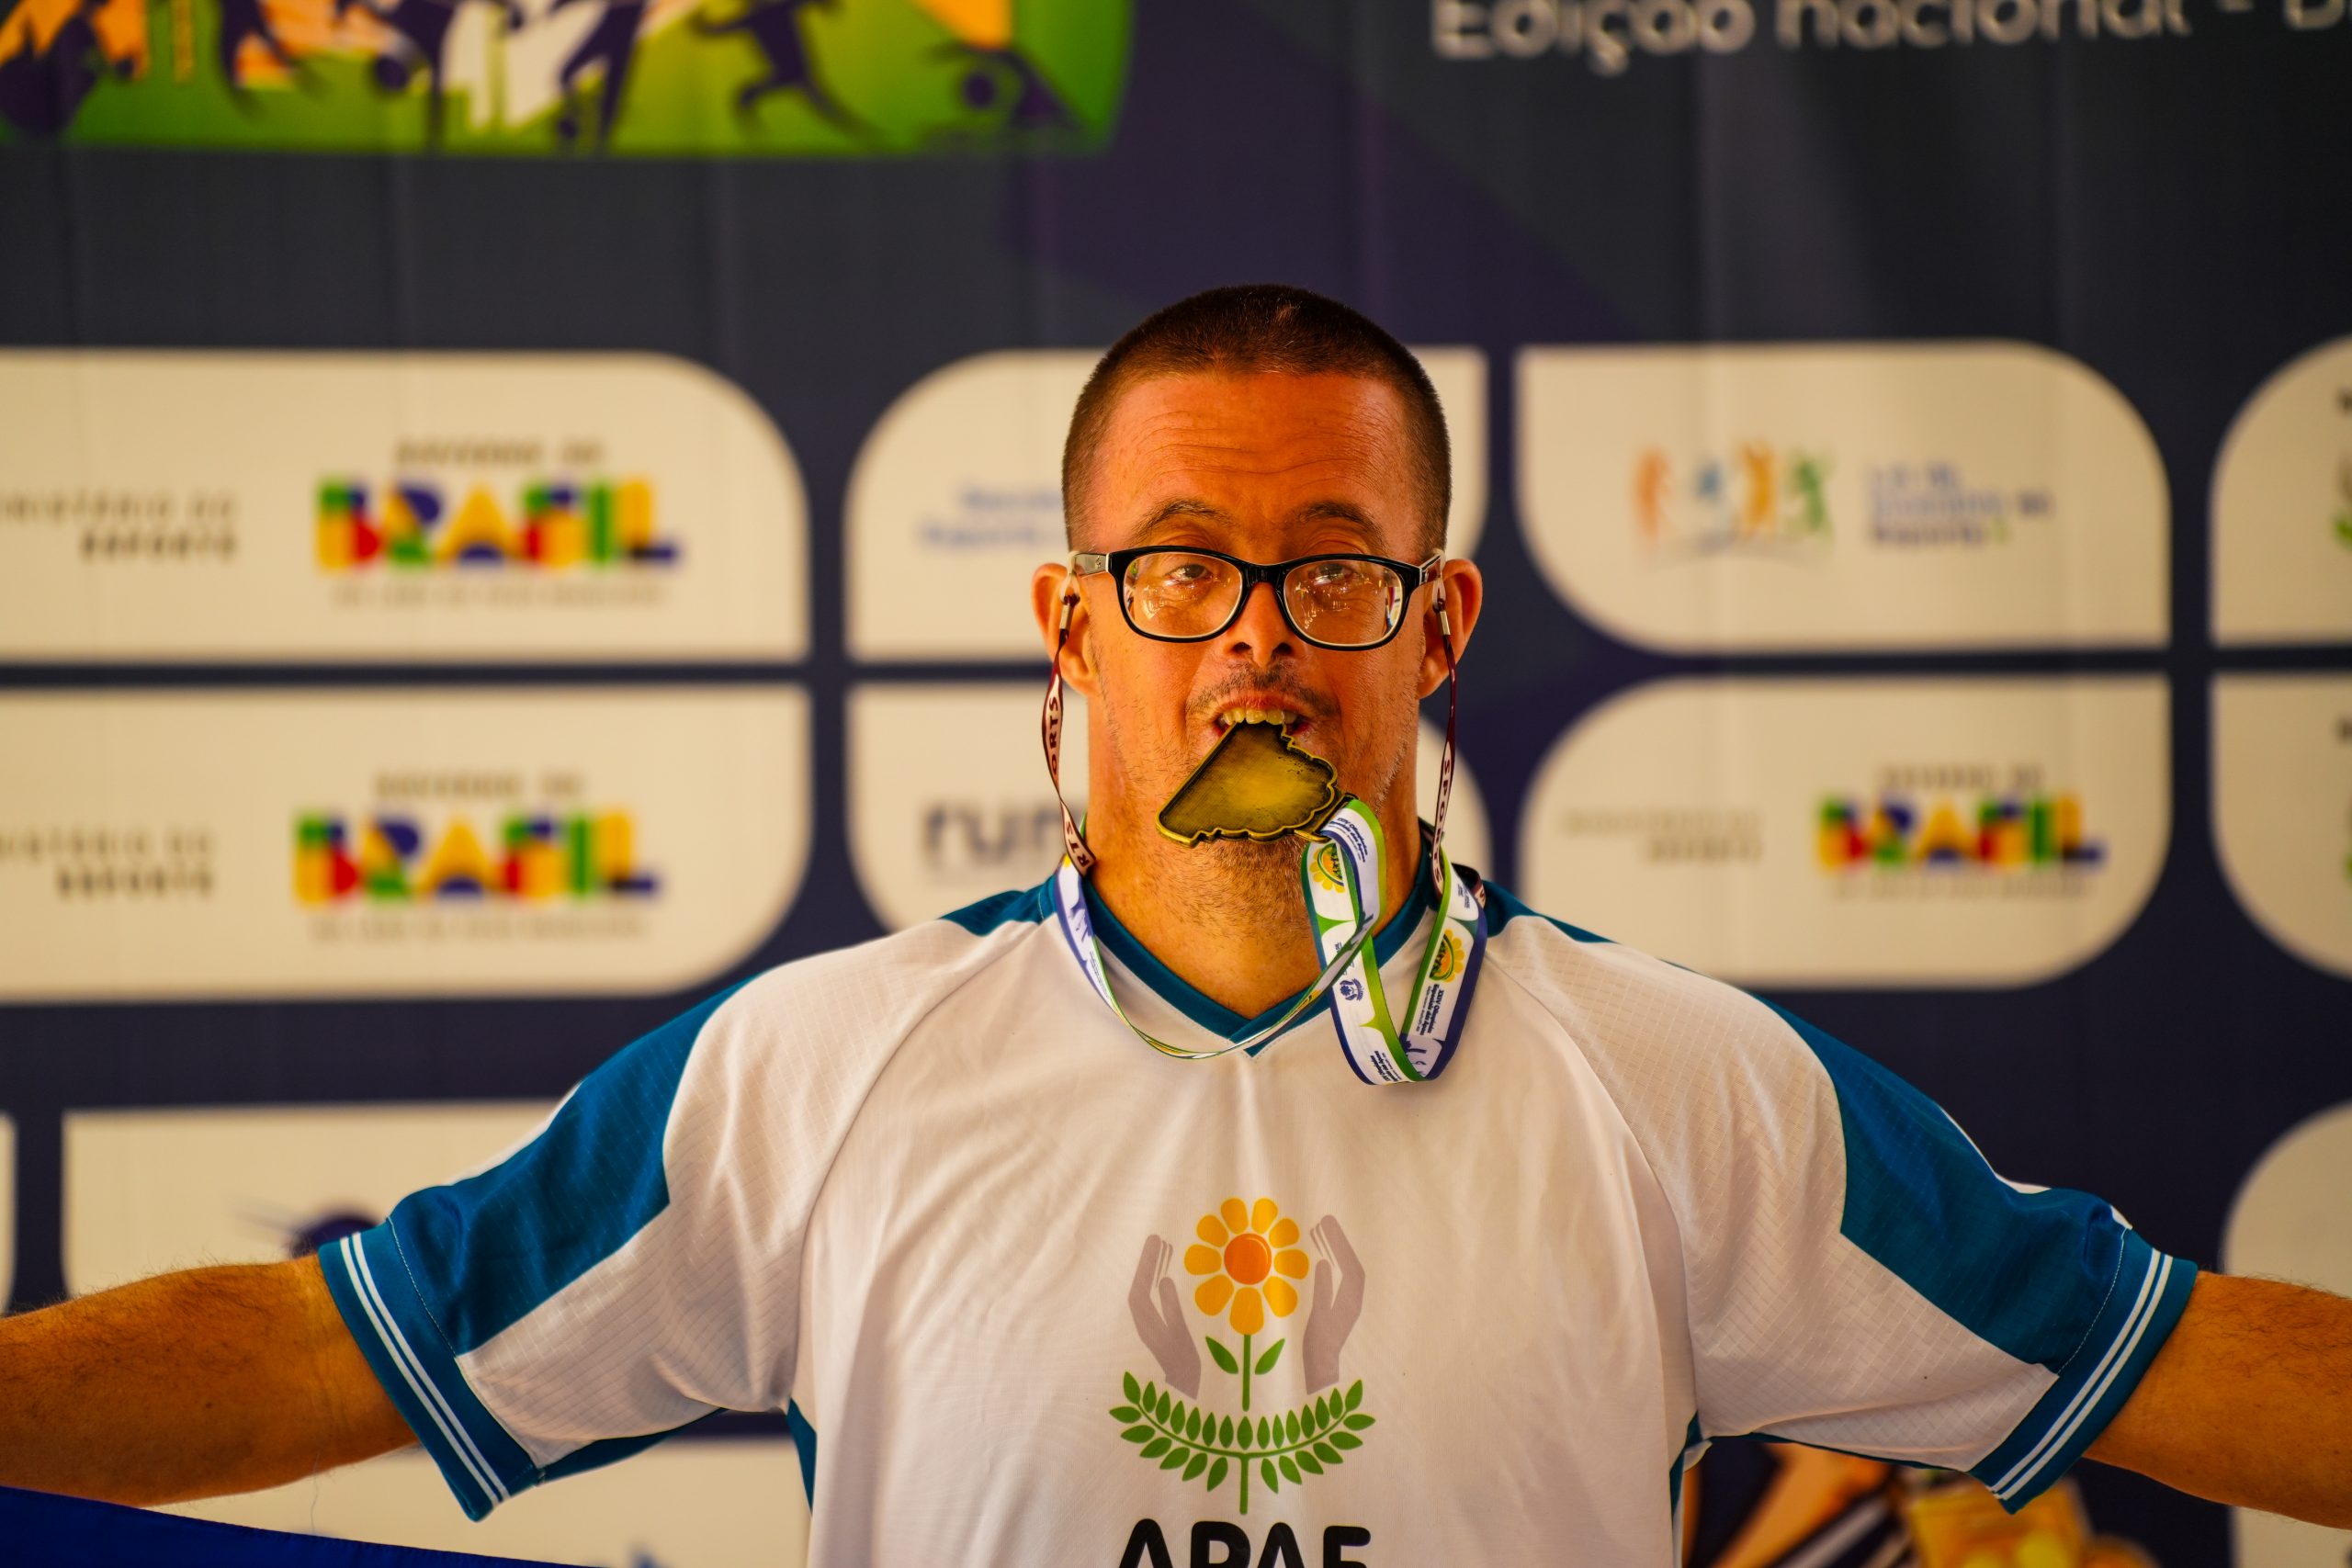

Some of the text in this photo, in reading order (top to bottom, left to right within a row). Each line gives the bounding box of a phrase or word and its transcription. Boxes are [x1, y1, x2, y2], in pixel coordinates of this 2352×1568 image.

[316, 477, 684, 573] BRASIL
[1049, 696, 1059, 775] ORTS
[293, 809, 662, 906] BRASIL
[1818, 793, 2106, 873] BRASIL
